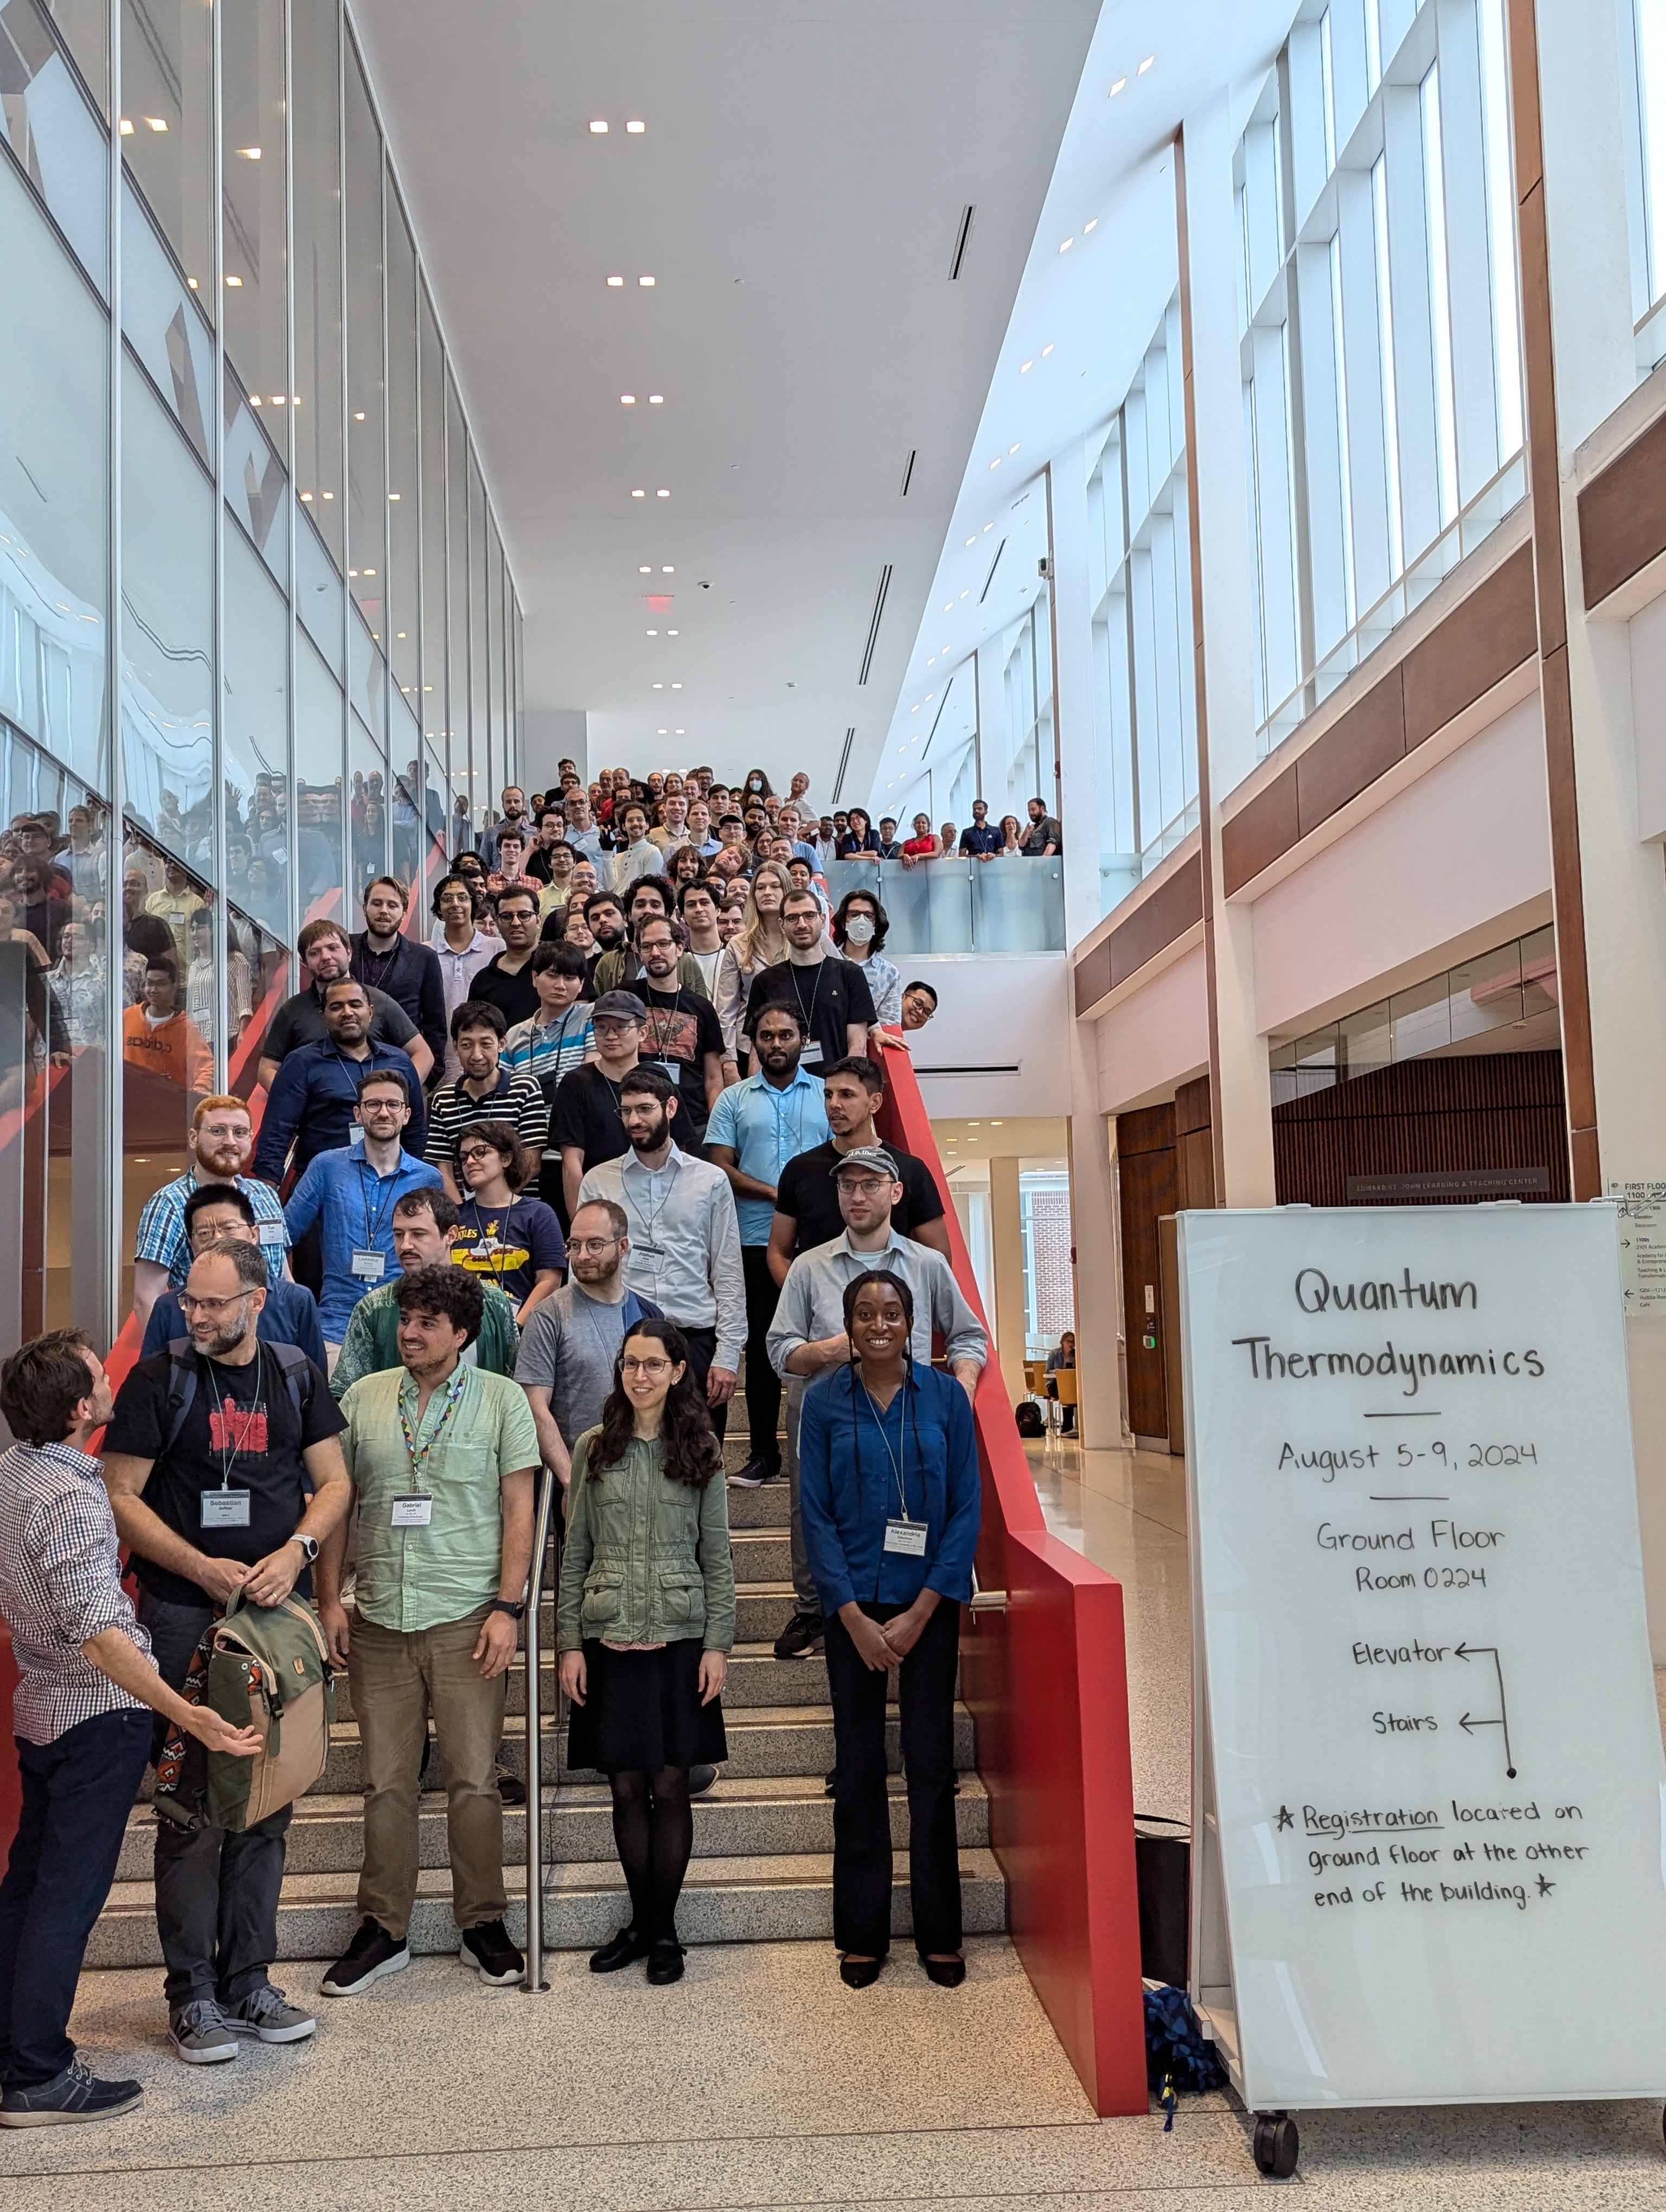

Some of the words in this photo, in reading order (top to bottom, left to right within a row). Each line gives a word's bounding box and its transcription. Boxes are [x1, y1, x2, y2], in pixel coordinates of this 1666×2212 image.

[1422, 1181, 1459, 1189] LEARNING
[456, 1229, 478, 1242] ATLES
[1295, 1268, 1477, 1313] Quantum
[1232, 1336, 1545, 1396] Thermodynamics
[1278, 1442, 1379, 1483] August
[1398, 1442, 1457, 1470] 5-9,
[1469, 1443, 1537, 1467] 2024
[1317, 1523, 1415, 1551] Ground
[1432, 1520, 1505, 1549] Floor
[1356, 1567, 1415, 1592] Room
[1424, 1567, 1486, 1588] 0224
[1353, 1639, 1451, 1664] Elevator
[1373, 1712, 1438, 1734] Stairs
[1303, 1805, 1439, 1840] Registration
[1452, 1800, 1540, 1822] located
[1555, 1806, 1582, 1819] on
[1309, 1847, 1380, 1875] ground
[1389, 1844, 1440, 1863] floor
[1453, 1842, 1475, 1861] at
[1483, 1843, 1517, 1861] the
[1526, 1843, 1590, 1860] other
[1315, 1887, 1353, 1906] end
[1362, 1881, 1386, 1902] of
[1401, 1882, 1433, 1902] the
[1440, 1881, 1530, 1910] building.
